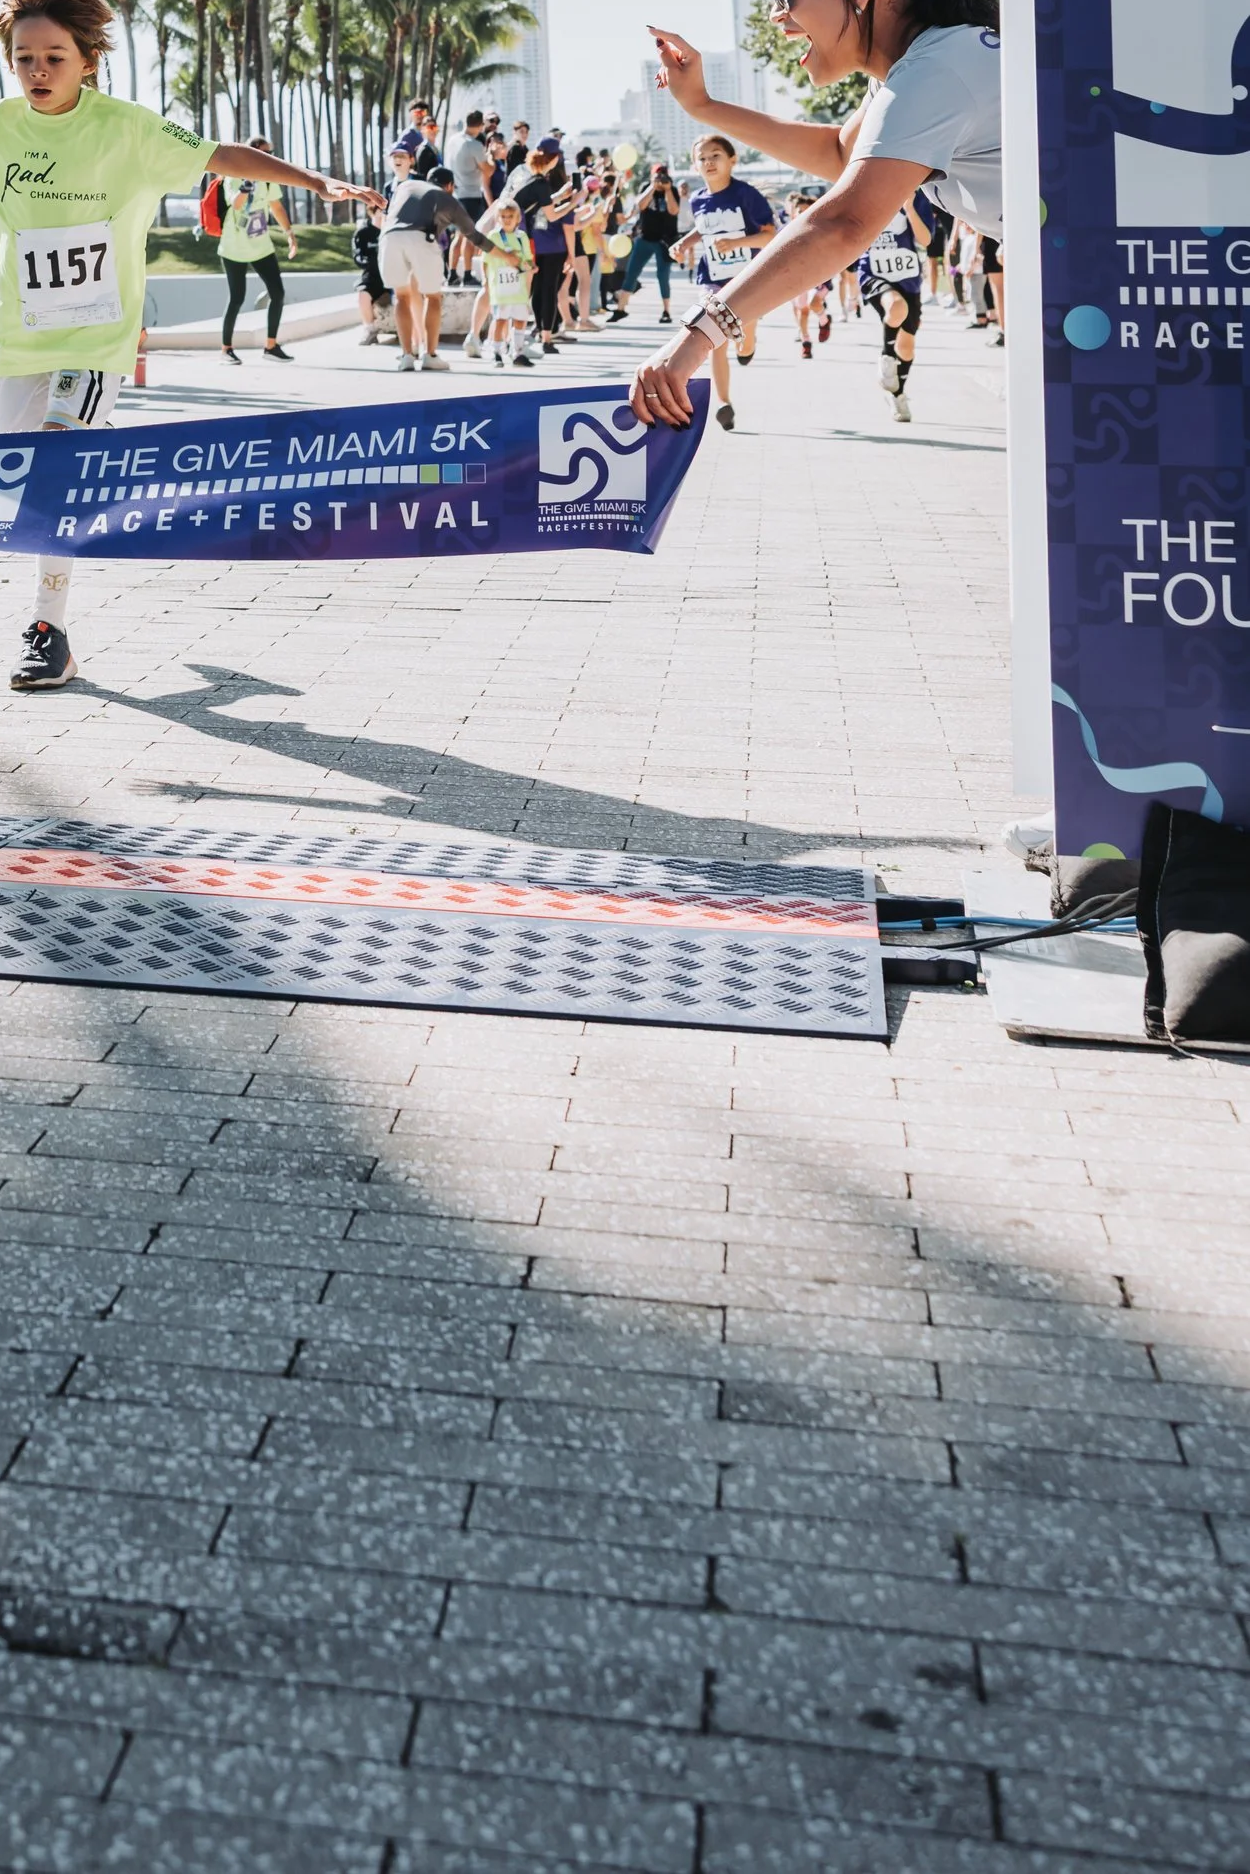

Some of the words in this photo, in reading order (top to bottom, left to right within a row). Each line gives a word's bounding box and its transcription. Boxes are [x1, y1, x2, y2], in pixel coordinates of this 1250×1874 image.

[24, 151, 40, 160] I'M
[42, 152, 49, 160] A
[1, 161, 56, 203] Rad.
[29, 190, 107, 201] CHANGEMAKER
[24, 242, 107, 289] 1157
[875, 256, 915, 274] 1182
[1116, 240, 1209, 275] THE
[1121, 322, 1244, 349] RACE
[75, 447, 160, 479] THE
[172, 439, 272, 473] GIVE
[287, 427, 417, 465] MIAMI
[430, 419, 493, 453] 5K
[56, 501, 489, 537] RACE+FESTIVAL
[538, 505, 561, 515] THE
[564, 503, 591, 514] GIVE
[594, 502, 629, 513] MIAMI
[631, 503, 647, 514] 5K
[1122, 519, 1237, 564] THE
